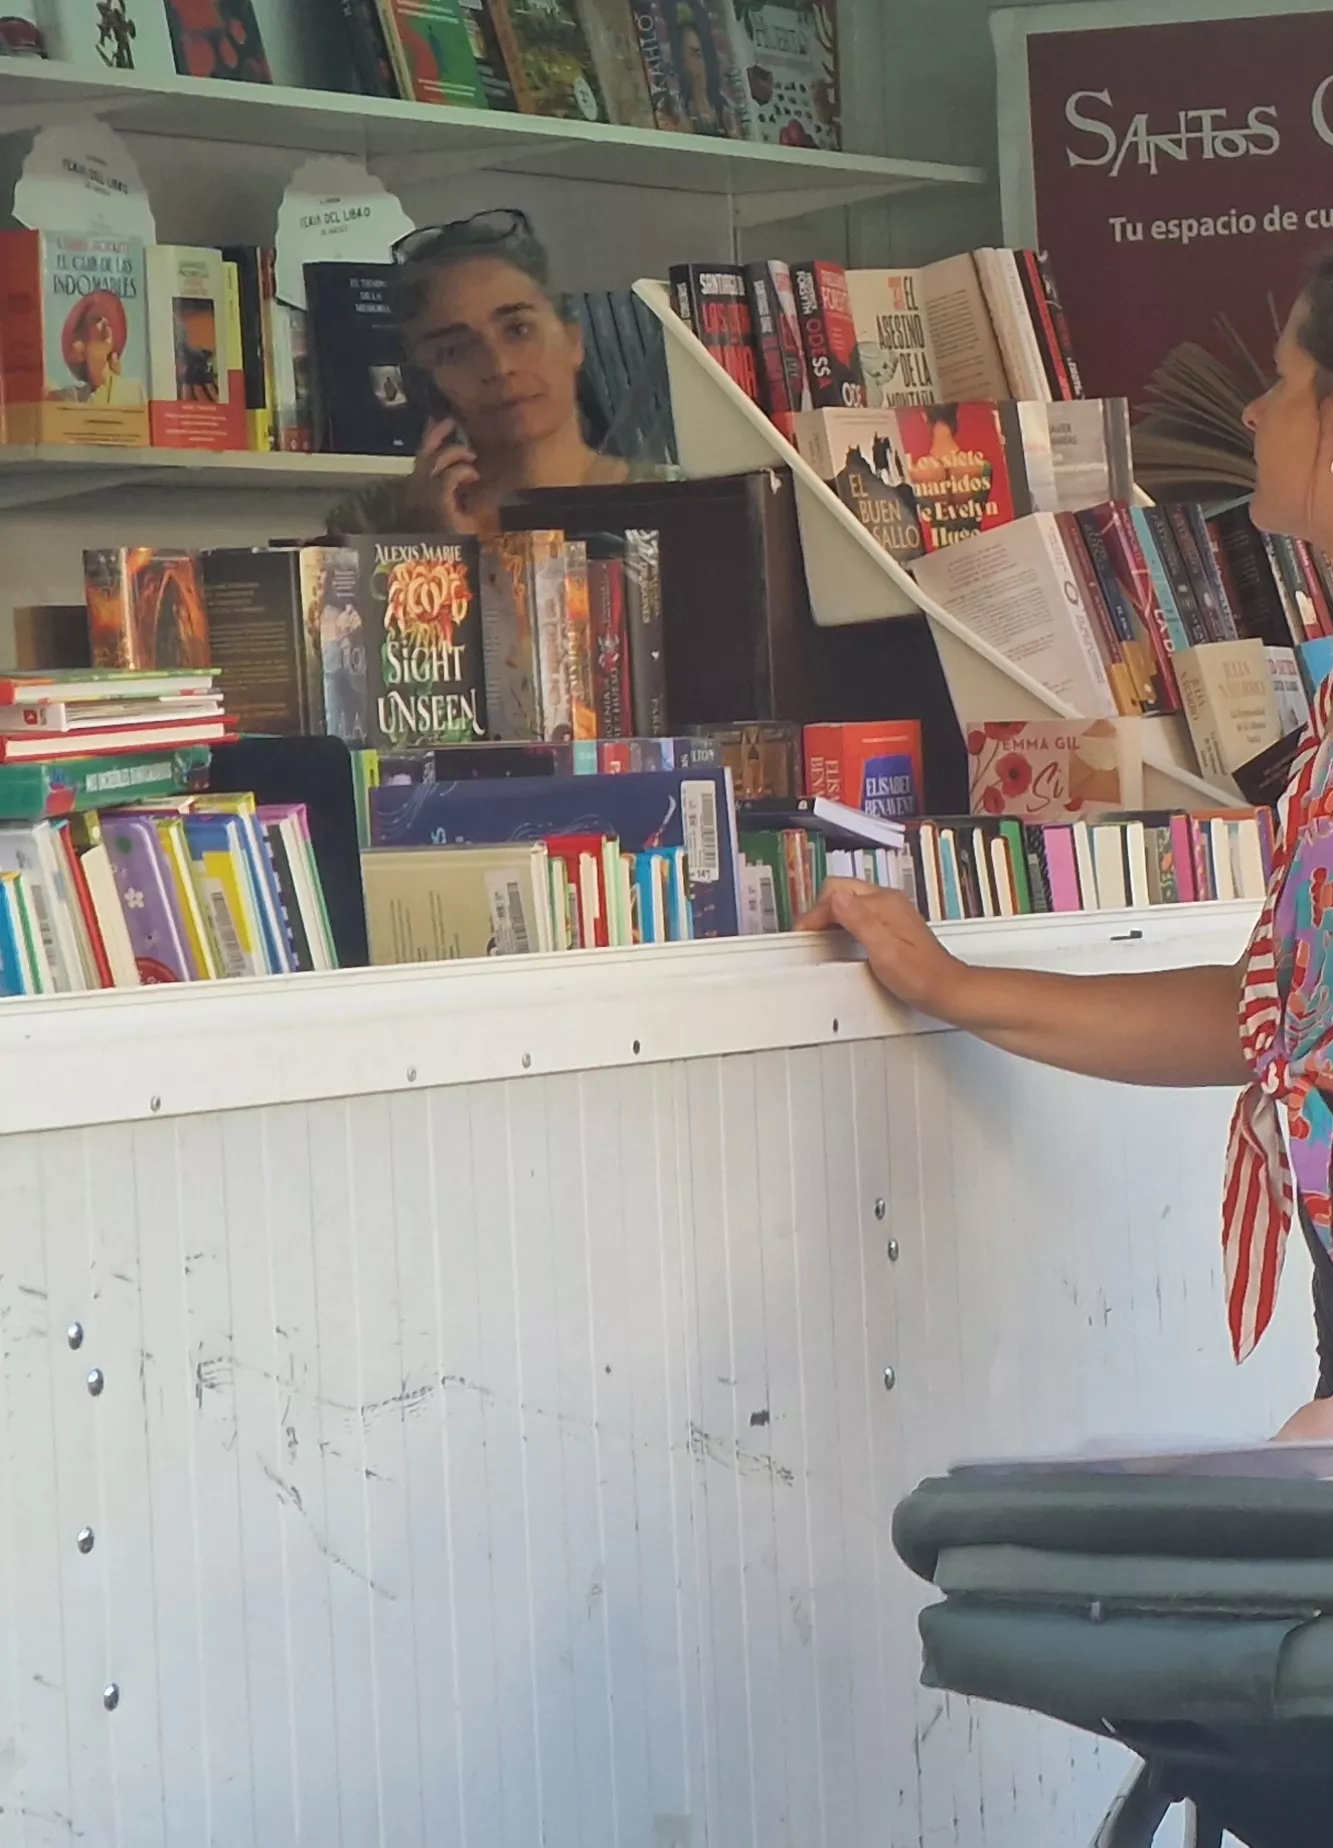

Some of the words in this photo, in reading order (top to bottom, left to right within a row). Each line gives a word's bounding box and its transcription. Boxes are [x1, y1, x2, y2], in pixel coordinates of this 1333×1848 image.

[1065, 88, 1280, 177] SANTOS
[1109, 216, 1143, 243] Tu
[1150, 208, 1257, 245] espacio
[1263, 204, 1299, 232] de
[903, 275, 920, 311] EL
[875, 314, 926, 350] ASESINO
[848, 473, 869, 498] EL
[859, 499, 901, 524] BUEN
[933, 499, 999, 523] Evelyn
[374, 543, 420, 566] ALEXIS
[420, 541, 463, 567] MARIE
[376, 688, 486, 737] UNSEEN
[1002, 738, 1049, 751] EMMA
[1054, 736, 1081, 750] GIL
